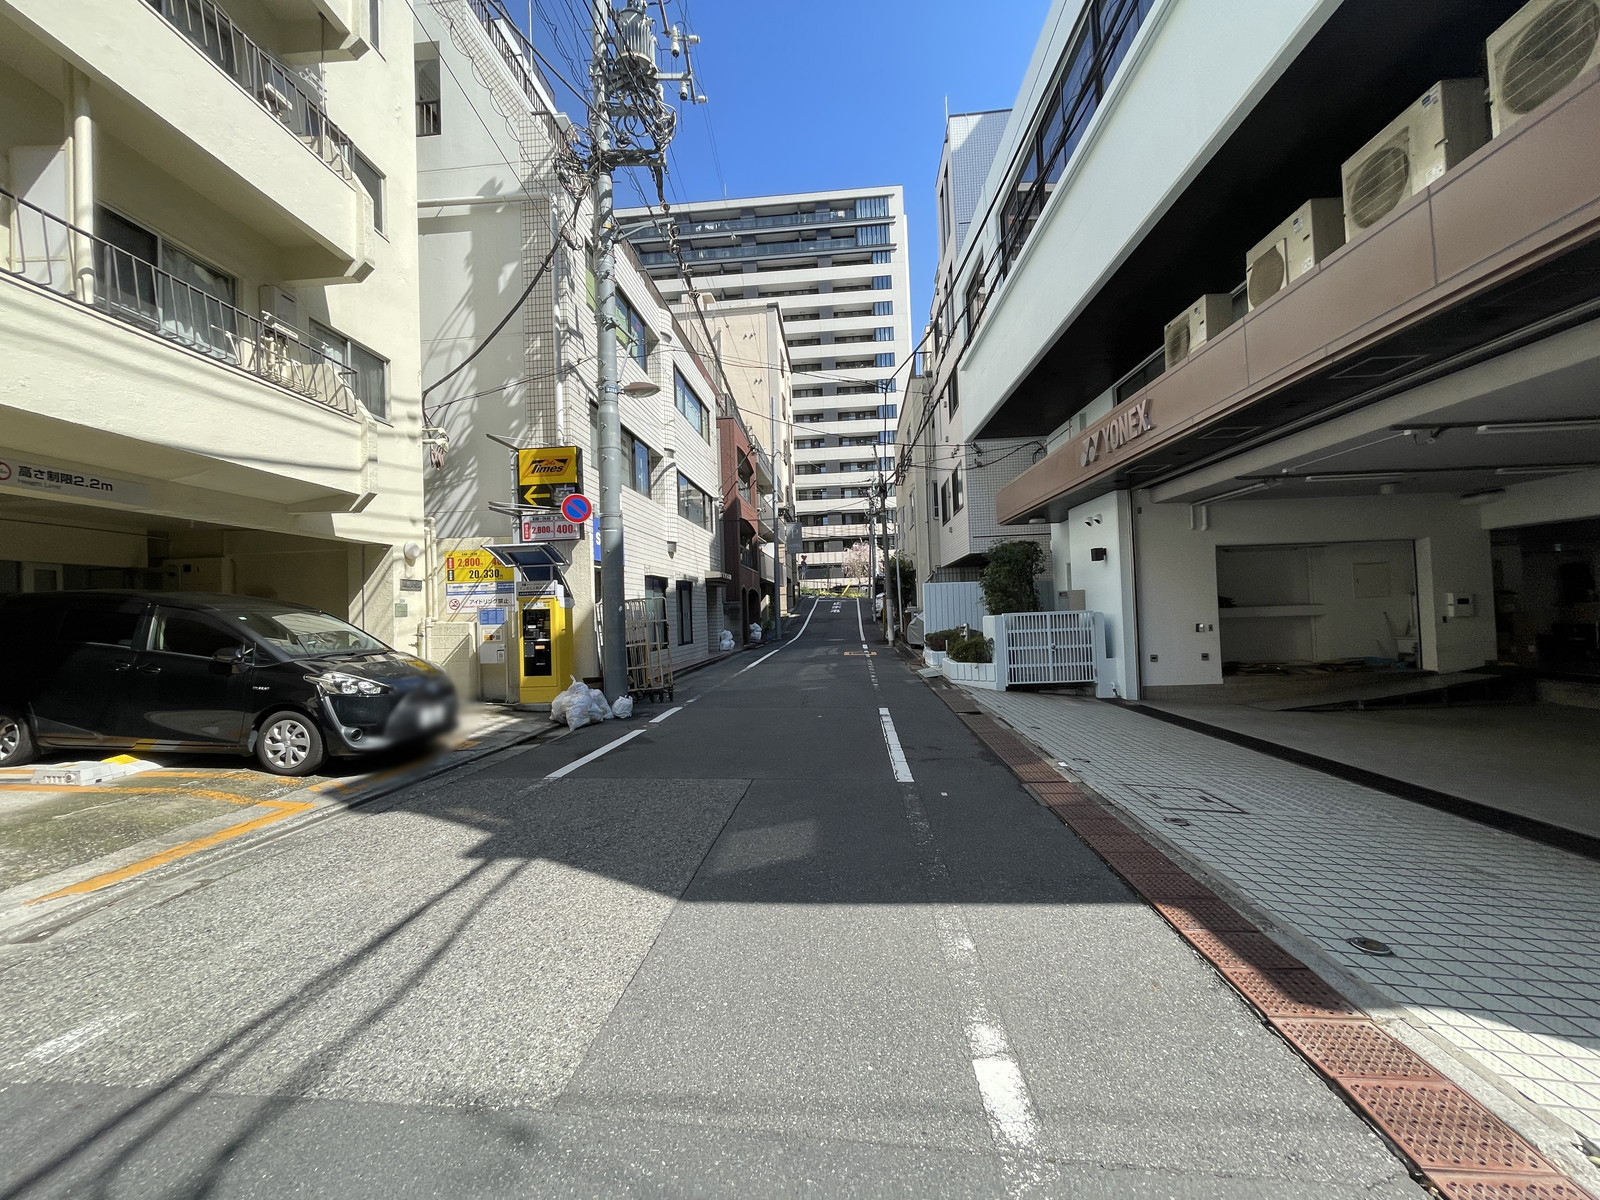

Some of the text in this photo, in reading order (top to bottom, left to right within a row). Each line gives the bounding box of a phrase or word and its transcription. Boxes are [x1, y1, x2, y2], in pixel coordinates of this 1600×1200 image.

[1102, 399, 1152, 453] YONEX
[18, 465, 113, 492] 高さ制限2.2m
[531, 463, 565, 474] Times
